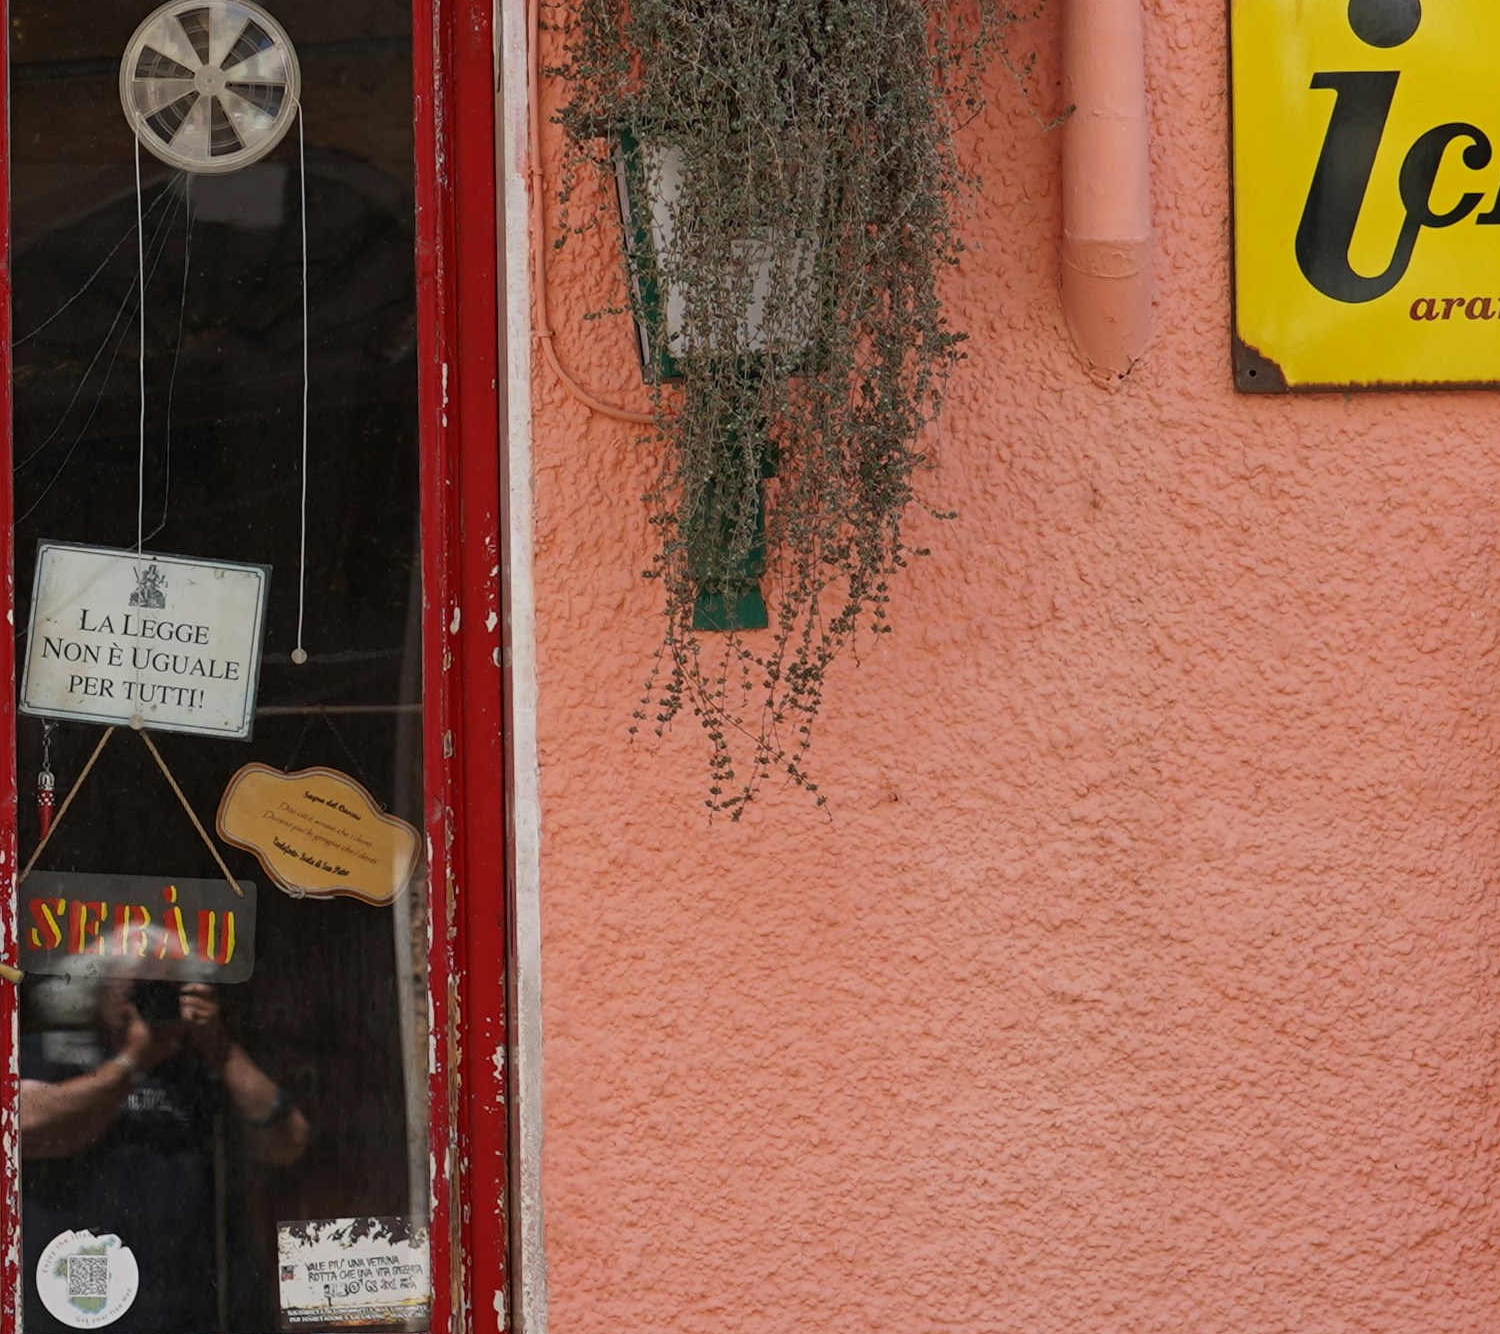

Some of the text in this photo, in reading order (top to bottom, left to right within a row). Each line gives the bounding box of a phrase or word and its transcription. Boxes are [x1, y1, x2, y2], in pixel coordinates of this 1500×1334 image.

[79, 609, 210, 645] LA LEGGE
[40, 637, 240, 682] NON È UGUALE
[67, 675, 205, 710] PER TUTTI!
